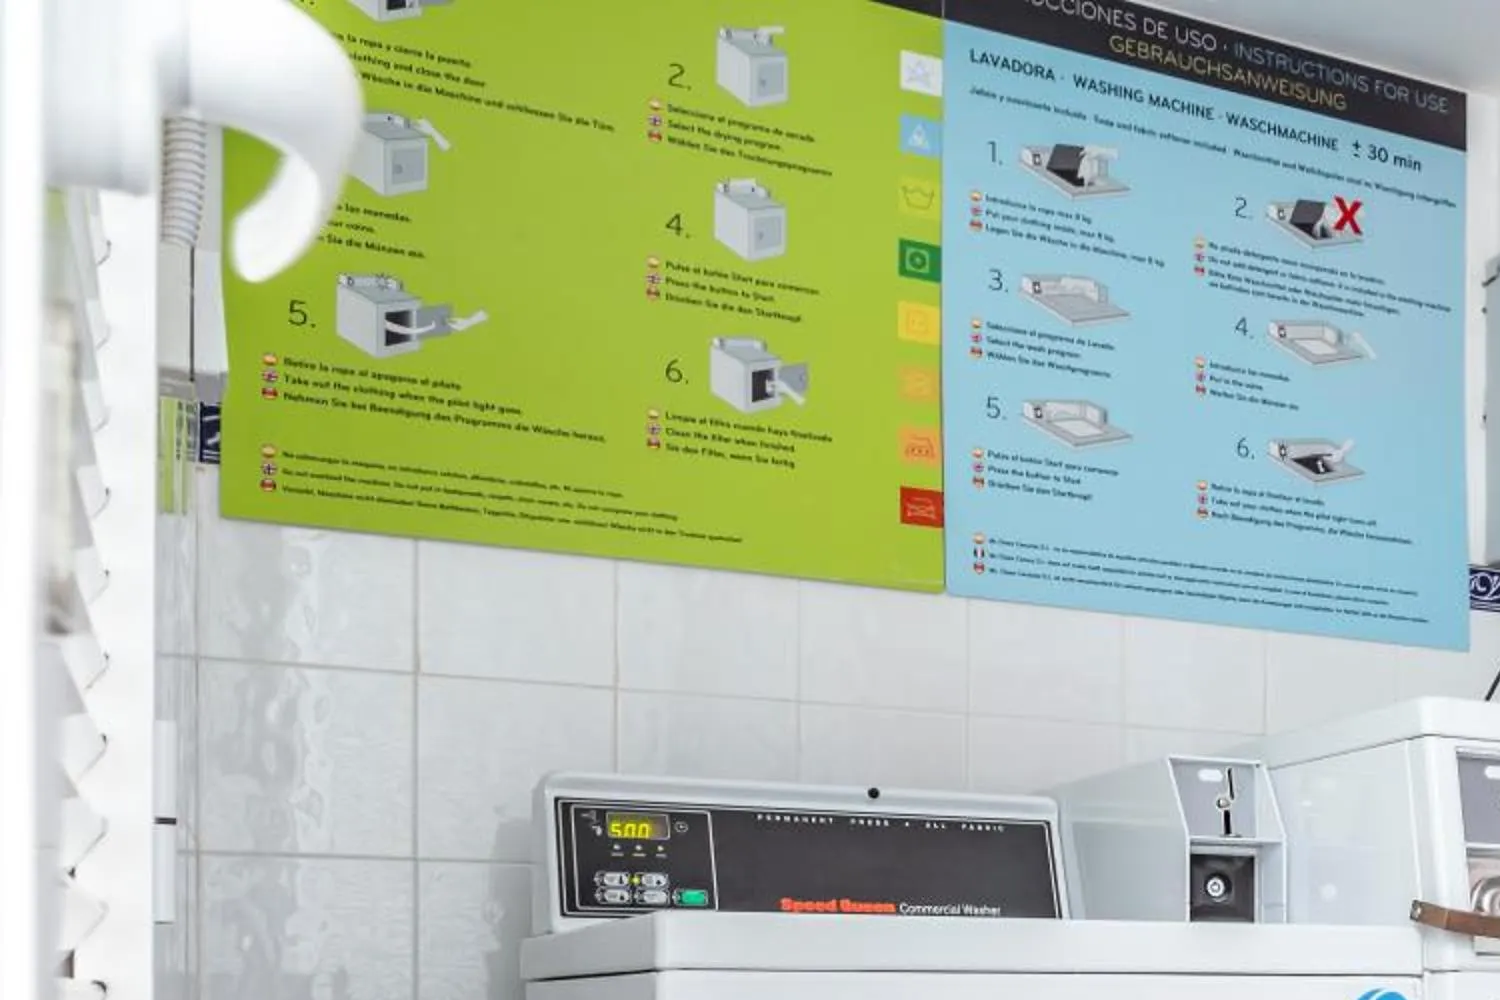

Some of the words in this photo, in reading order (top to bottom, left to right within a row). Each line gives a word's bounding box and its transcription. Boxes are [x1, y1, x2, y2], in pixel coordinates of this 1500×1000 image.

[667, 63, 692, 91] 2.
[1109, 35, 1348, 111] GEBRAUCHSANWEISUNG
[1143, 17, 1169, 40] DE
[1175, 26, 1217, 51] USO
[1234, 42, 1369, 93] INSTRUCTIONS
[1375, 79, 1409, 103] FOR
[1415, 89, 1450, 114] USE
[970, 49, 1056, 81] LAVADORA
[1073, 74, 1144, 103] WASHING
[1149, 94, 1215, 121] MACHINE
[1226, 112, 1339, 151] WASCHMACHINE
[1368, 145, 1389, 164] 30
[1393, 153, 1421, 172] min
[665, 213, 692, 239] 4.
[288, 300, 316, 328] 5.
[665, 358, 689, 385] 6.
[987, 396, 1007, 420] 5.
[780, 897, 837, 913] Speed
[839, 899, 897, 914] Queen
[899, 902, 961, 915] Commercial
[962, 903, 1001, 916] Washer
